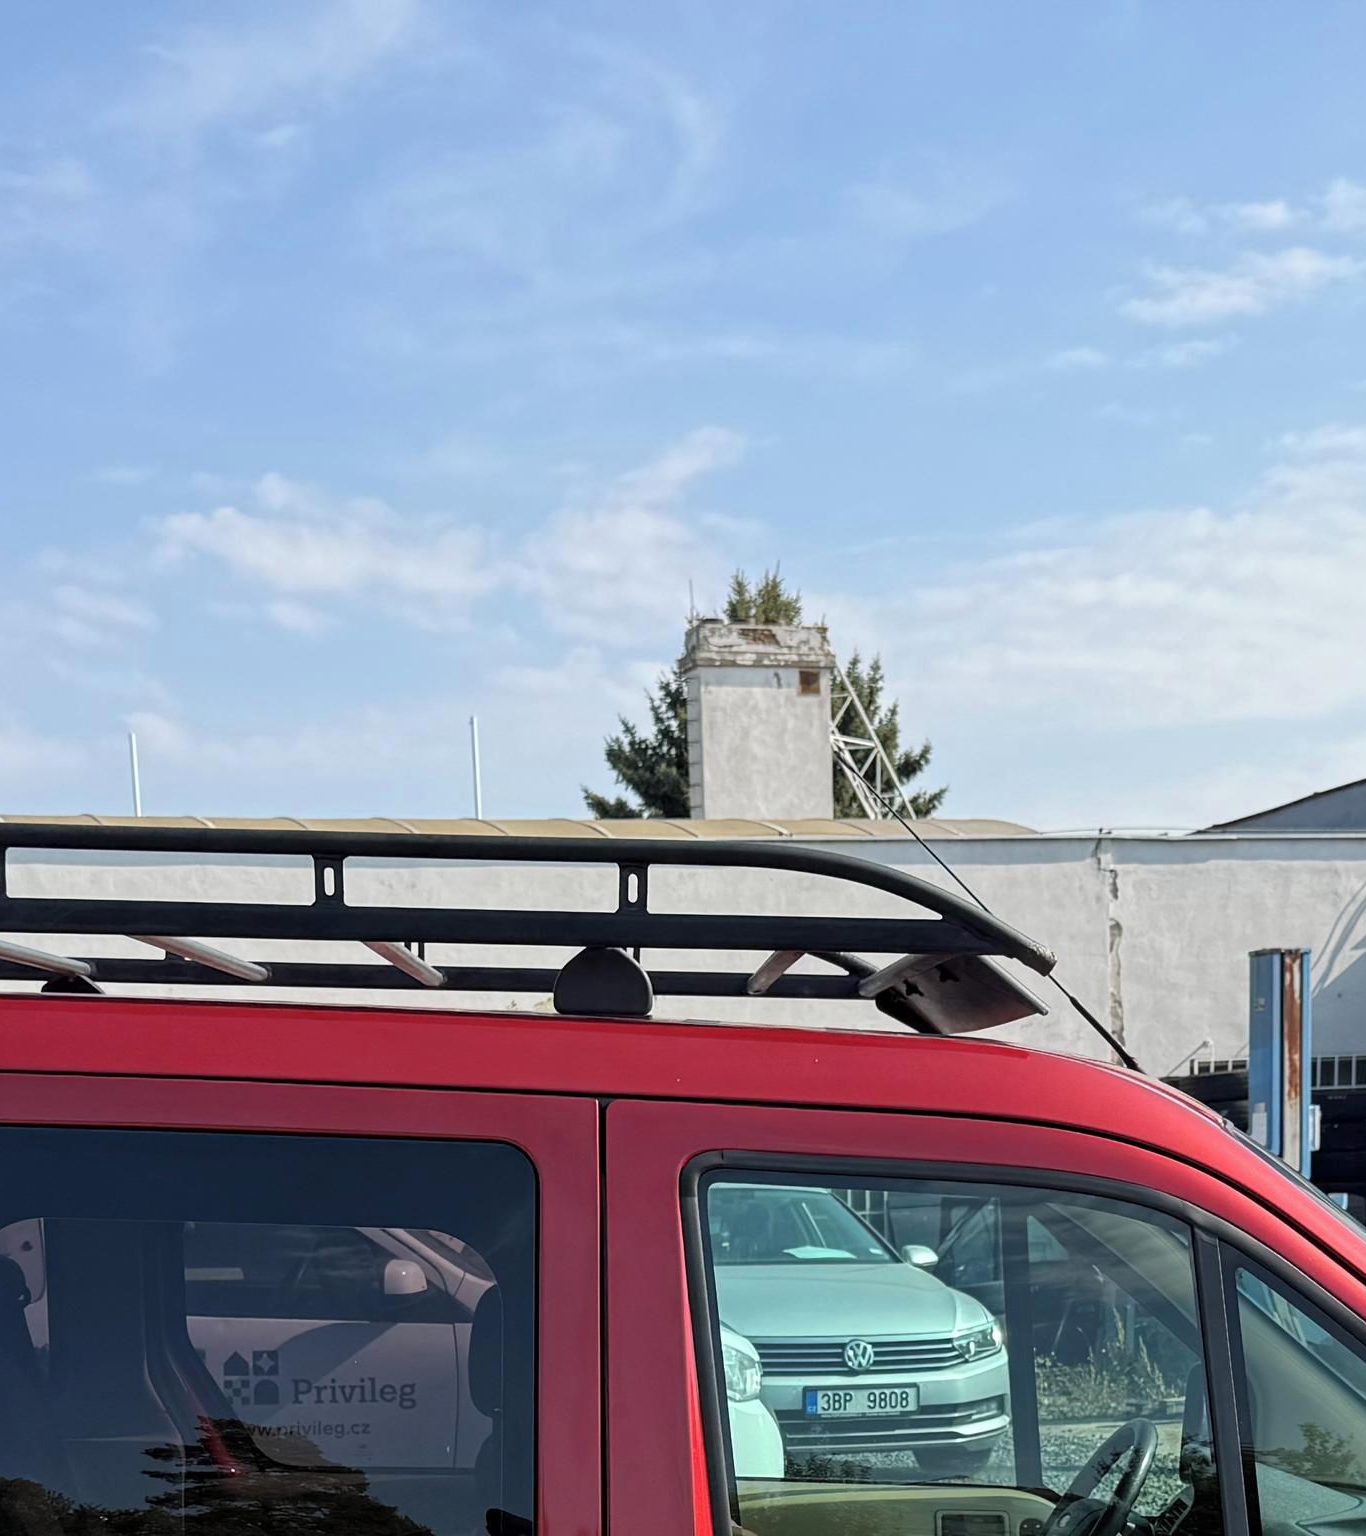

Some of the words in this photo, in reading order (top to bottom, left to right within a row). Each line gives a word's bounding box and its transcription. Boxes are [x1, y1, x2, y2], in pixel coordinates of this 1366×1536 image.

[291, 1377, 417, 1410] Privileg
[821, 1392, 853, 1411] 3BP
[867, 1390, 909, 1410] 9808
[246, 1420, 372, 1439] ww.privileg.cz
